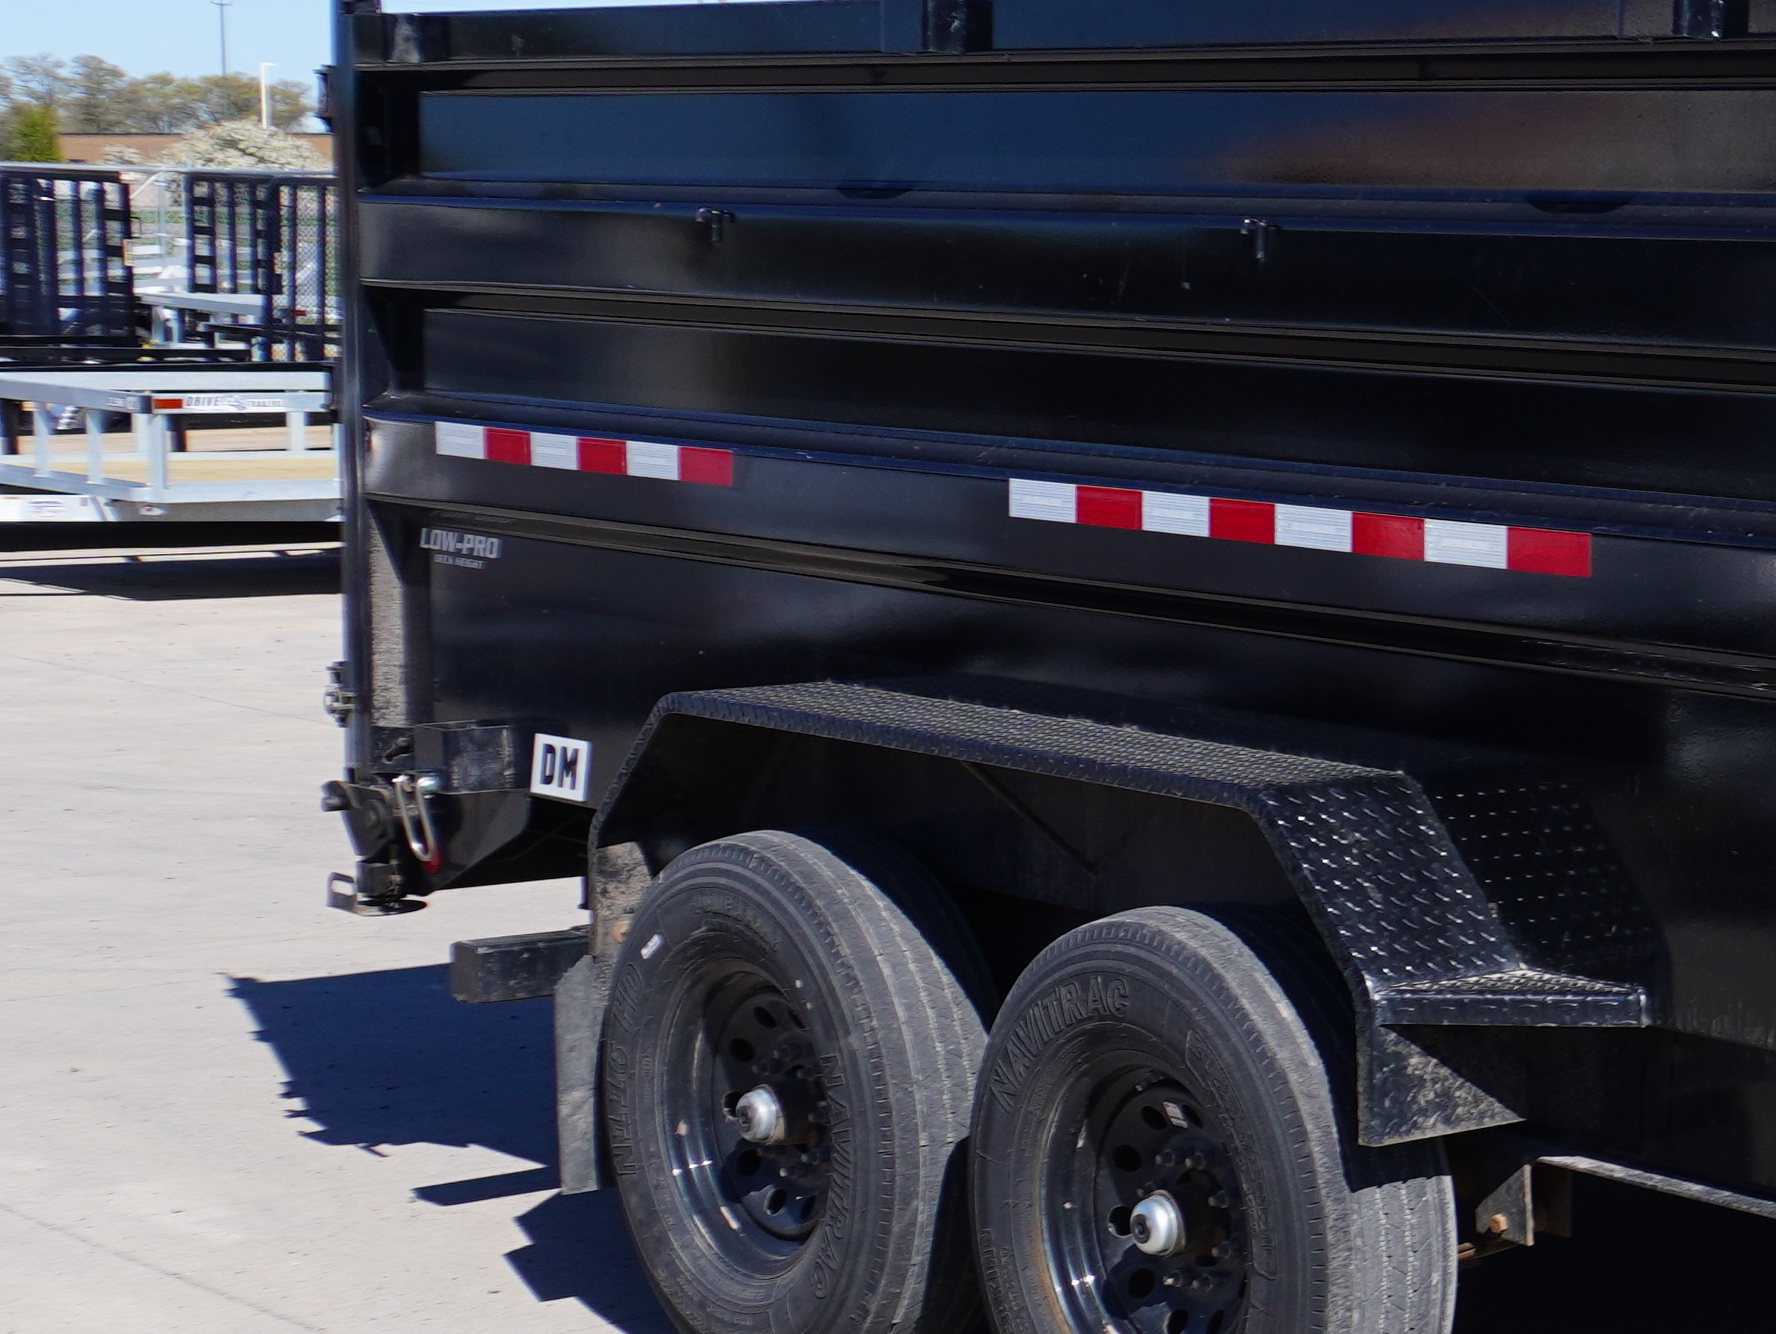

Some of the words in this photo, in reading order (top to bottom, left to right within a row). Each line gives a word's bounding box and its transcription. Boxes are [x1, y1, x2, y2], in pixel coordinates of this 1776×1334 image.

[419, 527, 502, 560] LOW-PRO
[540, 743, 580, 791] DM
[988, 974, 1131, 1115] NAVITRAC
[812, 1052, 854, 1300] NAVITRAC
